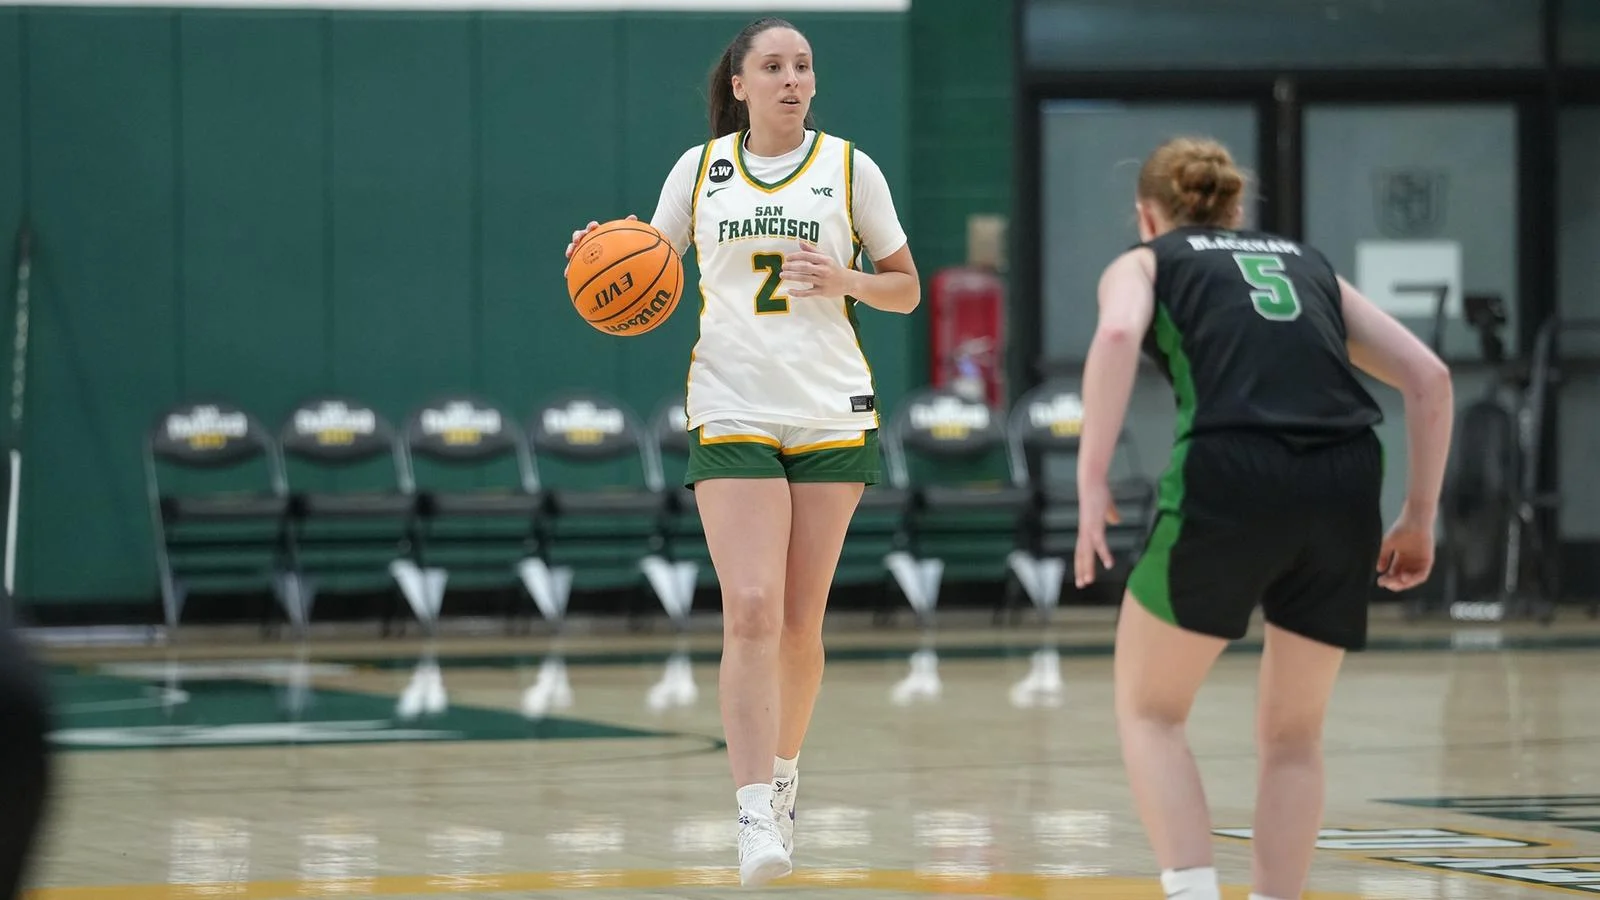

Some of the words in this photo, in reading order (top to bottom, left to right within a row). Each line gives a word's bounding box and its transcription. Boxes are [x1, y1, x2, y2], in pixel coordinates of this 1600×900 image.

[710, 166, 732, 177] LW
[811, 187, 833, 197] WCC
[755, 206, 784, 216] SAN
[718, 218, 820, 243] FRANCISCO
[595, 272, 634, 308] EVO
[751, 252, 790, 315] 2
[1232, 253, 1302, 322] 5
[603, 289, 672, 333] Wilson
